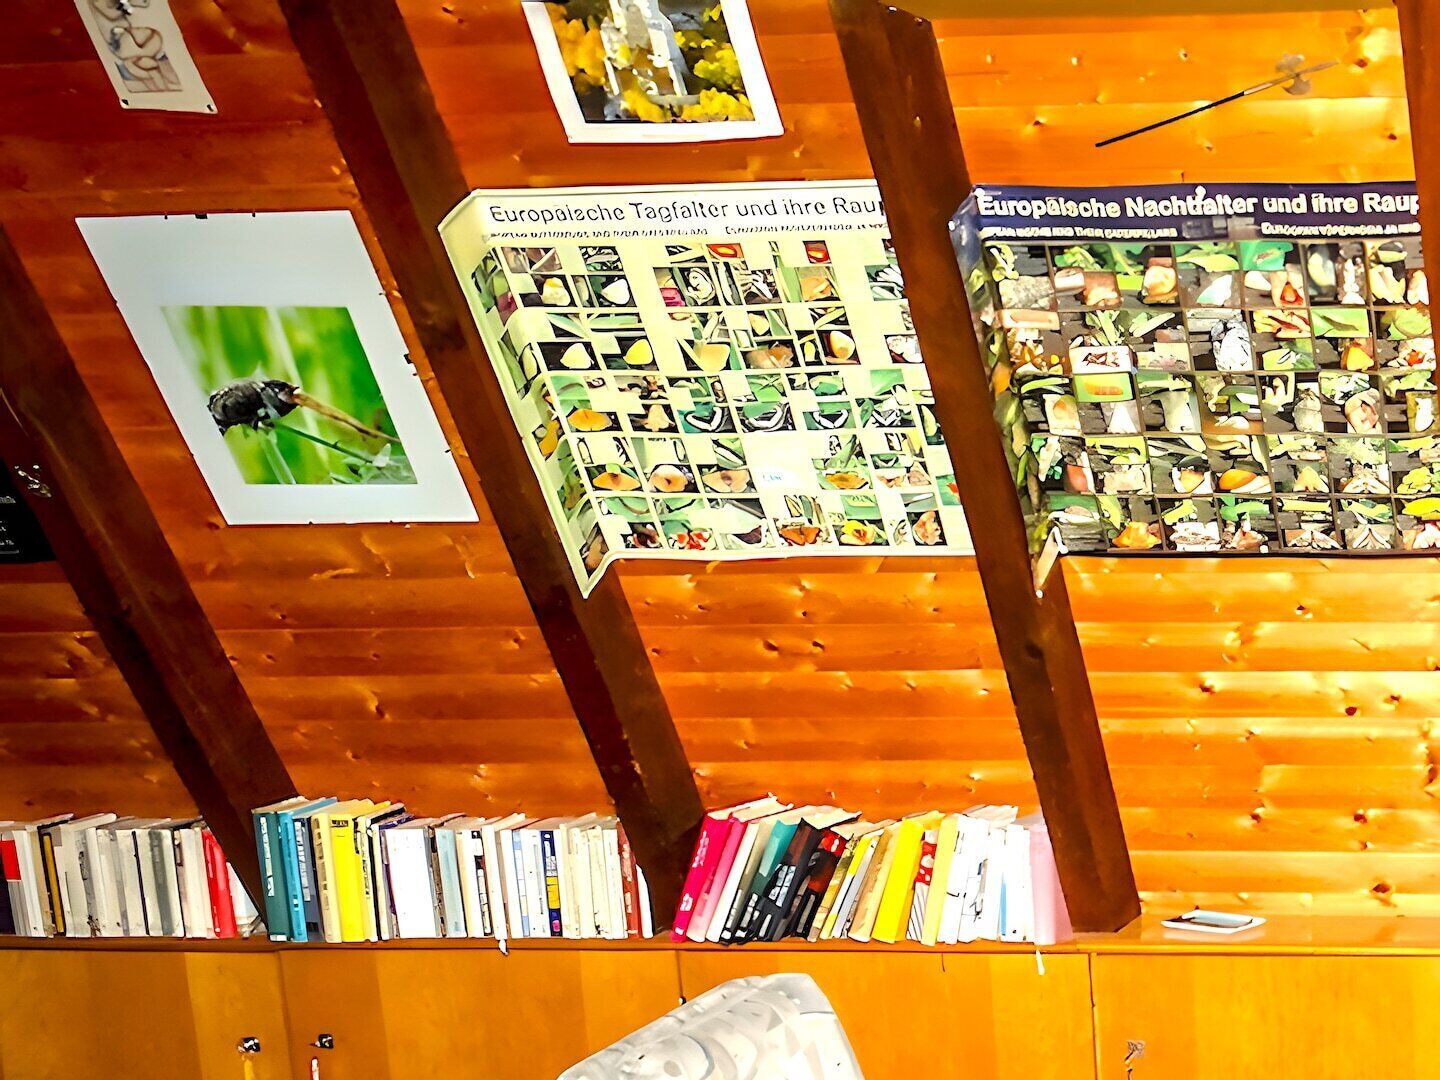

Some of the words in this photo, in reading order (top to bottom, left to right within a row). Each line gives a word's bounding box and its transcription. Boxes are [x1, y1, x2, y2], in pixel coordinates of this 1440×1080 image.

[489, 203, 626, 225] Europäische
[628, 200, 729, 223] Tagfalter
[735, 199, 778, 217] und
[781, 198, 827, 215] ihre
[976, 195, 1122, 220] Europäische
[1124, 194, 1259, 217] Nachtfalter
[1262, 193, 1308, 214] und
[1310, 192, 1359, 214] ihre
